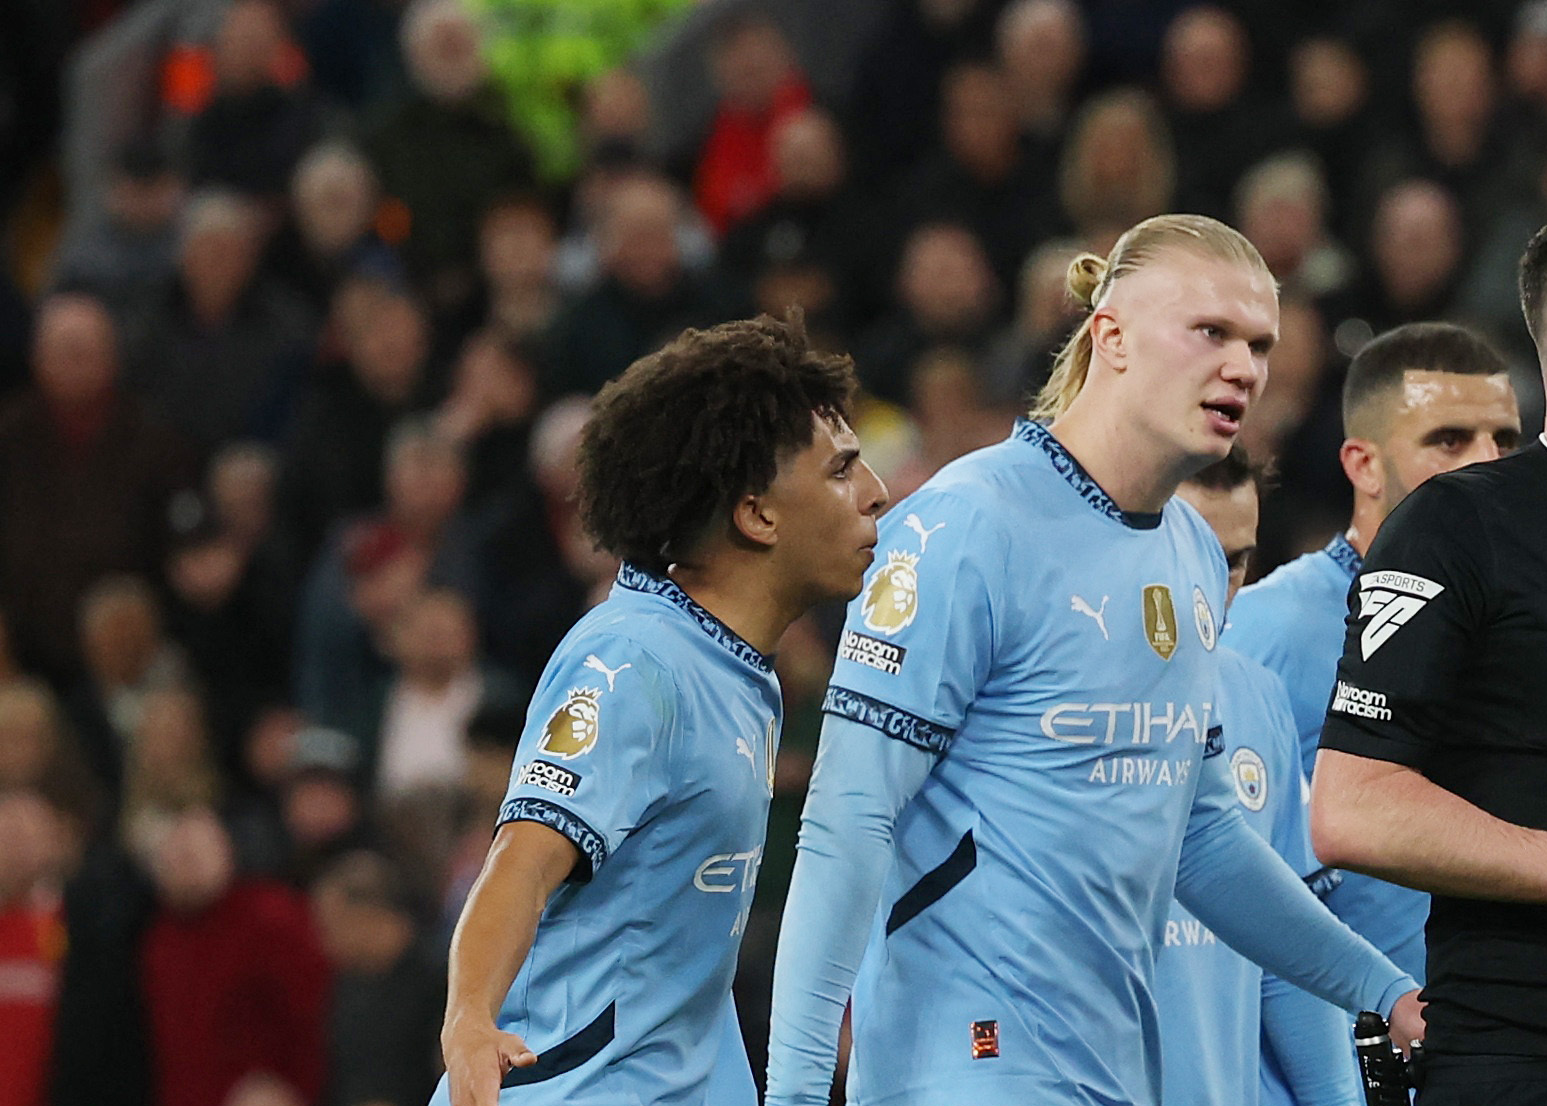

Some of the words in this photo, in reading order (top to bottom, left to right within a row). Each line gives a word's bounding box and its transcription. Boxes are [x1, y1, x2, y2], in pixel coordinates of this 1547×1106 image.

[1380, 573, 1426, 592] SPORTS
[857, 636, 899, 661] room
[851, 649, 901, 676] racism
[1348, 686, 1387, 707] room
[529, 762, 574, 786] room
